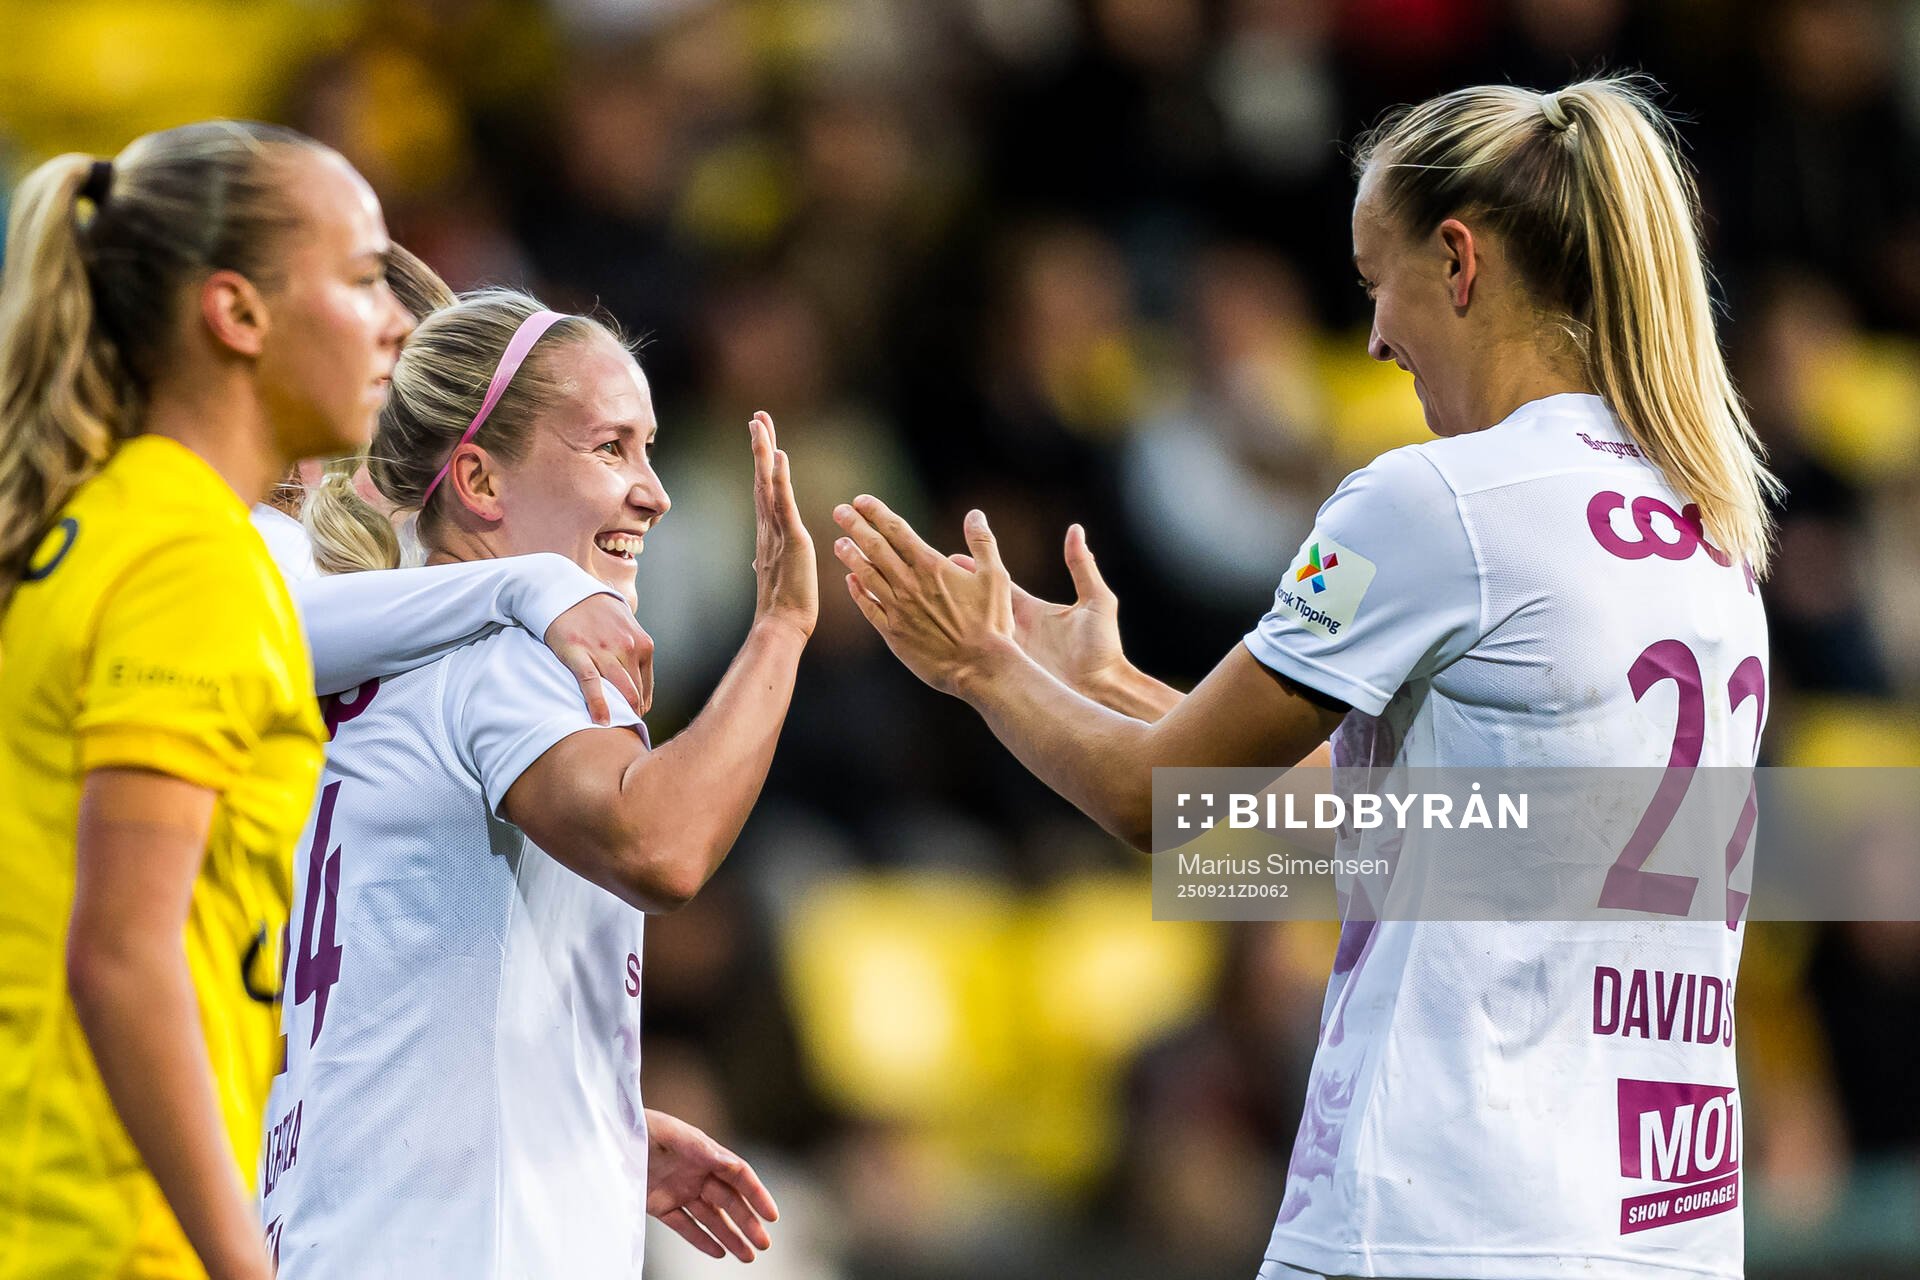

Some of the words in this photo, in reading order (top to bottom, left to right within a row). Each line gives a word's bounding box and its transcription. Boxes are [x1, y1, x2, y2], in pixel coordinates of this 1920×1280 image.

[1295, 596, 1342, 634] Tipping
[1597, 638, 1765, 932] 22
[1628, 1200, 1671, 1225] SHOW
[1674, 1184, 1736, 1214] COURAGE!
